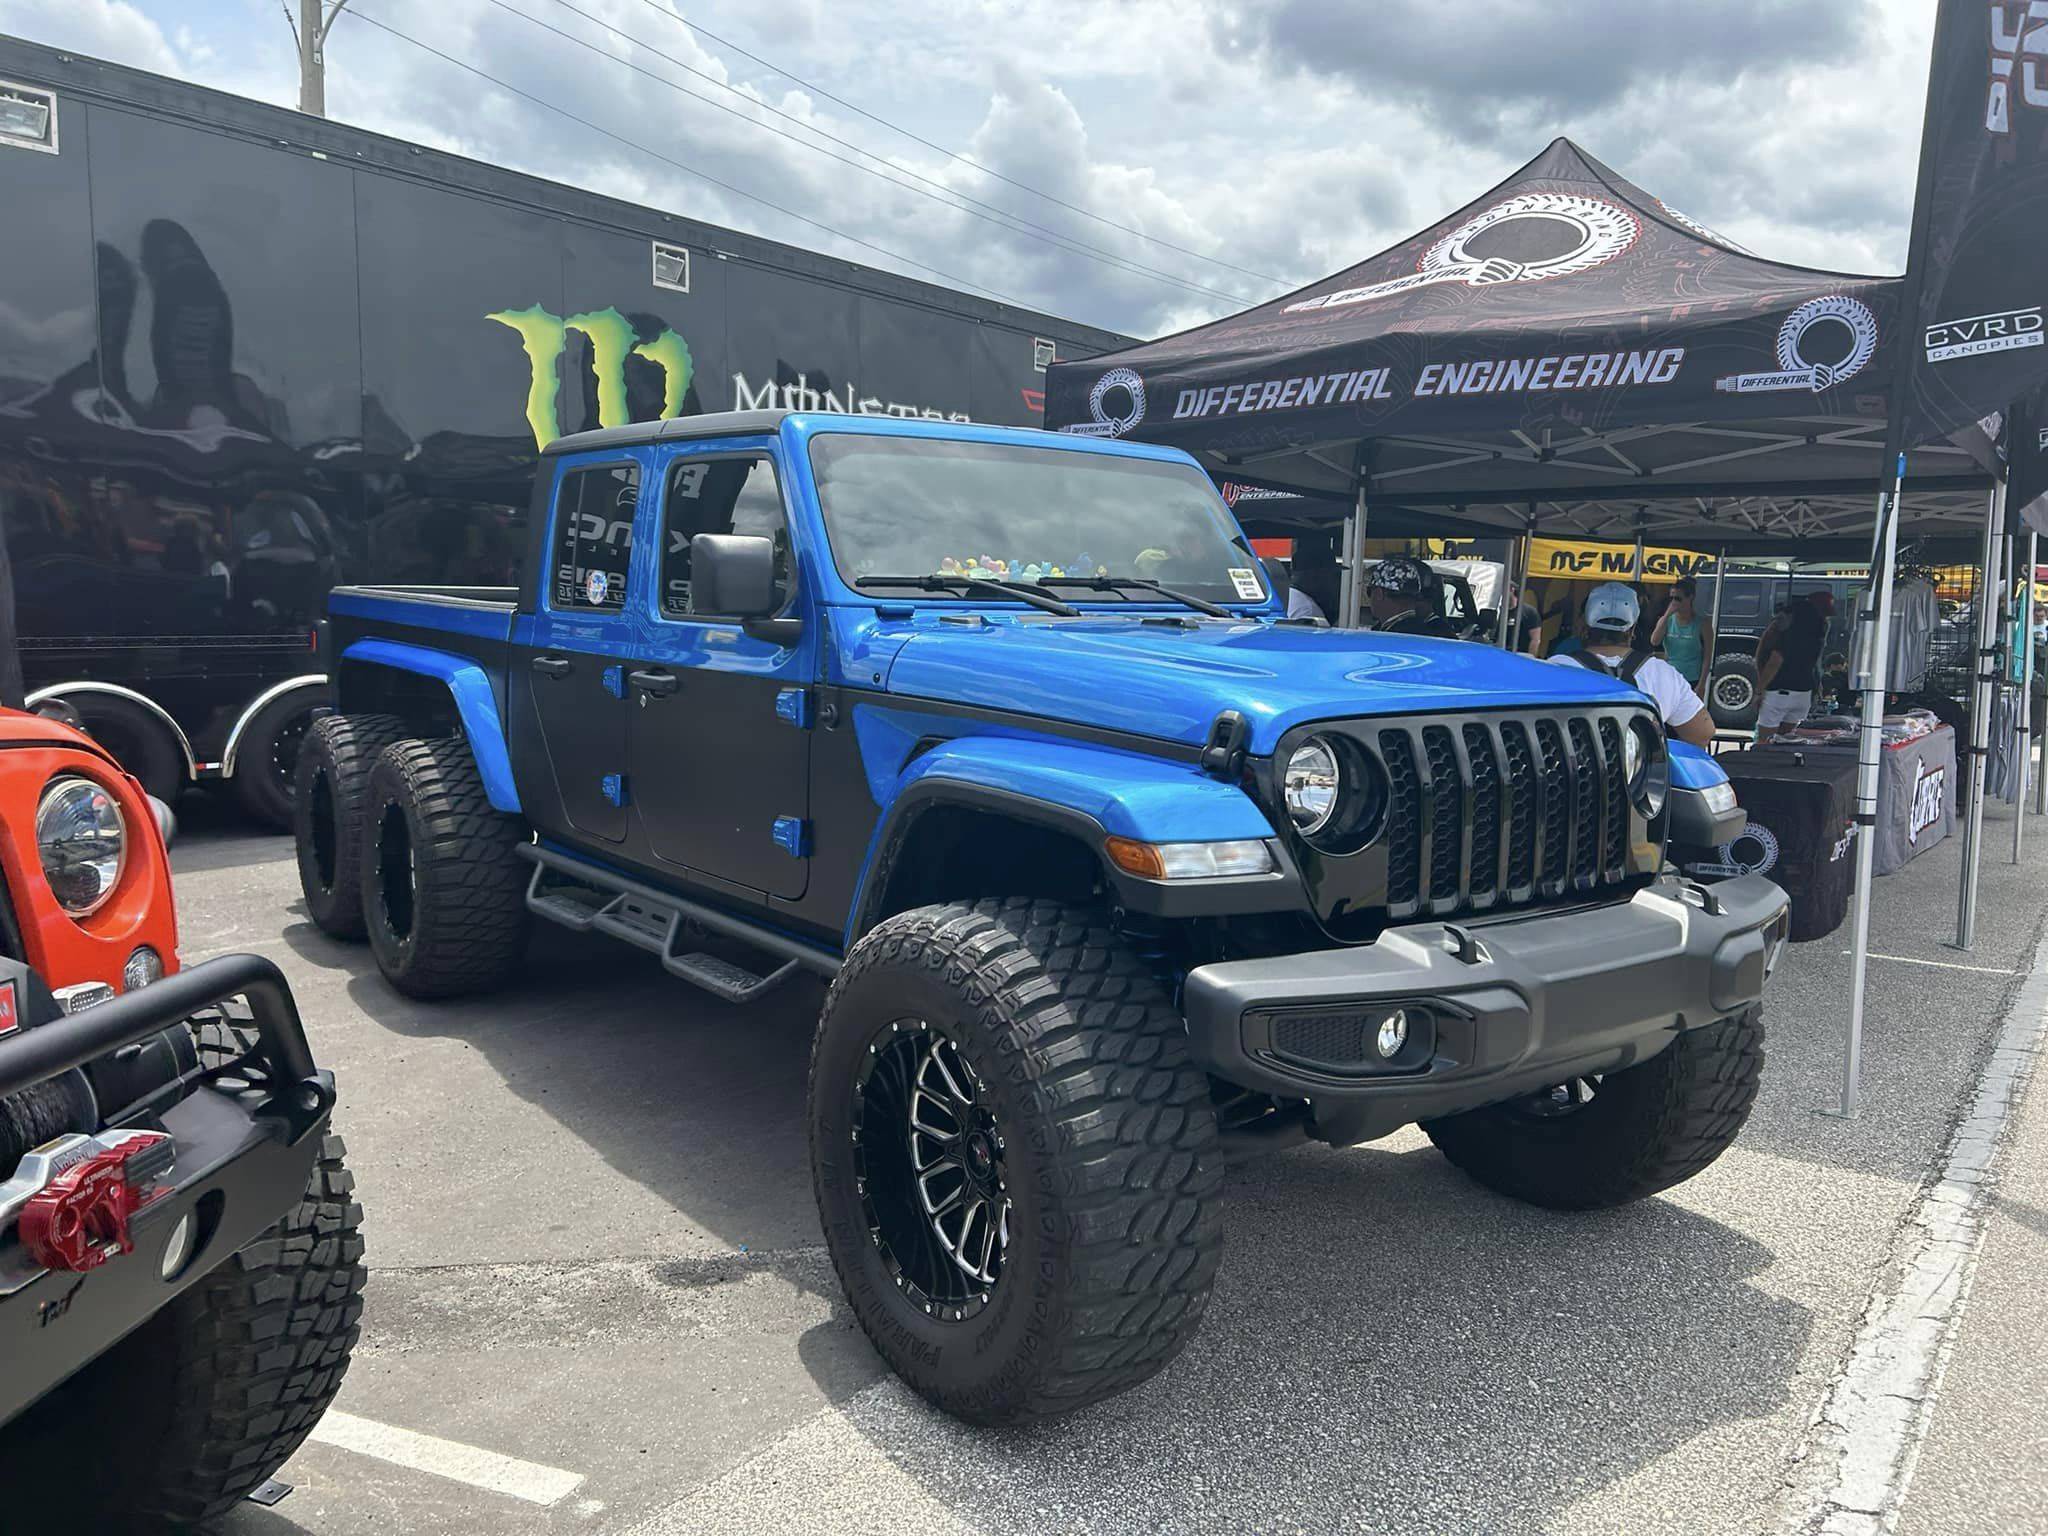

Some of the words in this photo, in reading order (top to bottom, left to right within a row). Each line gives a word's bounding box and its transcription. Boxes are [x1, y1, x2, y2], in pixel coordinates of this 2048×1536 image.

[1925, 314, 2043, 348] CVRD
[1932, 335, 2040, 359] CANOPIES
[1173, 367, 1392, 419] DIFFERENTIAL
[1414, 348, 1685, 396] ENGINEERING
[1741, 374, 1811, 388] DIFFERENTIAL
